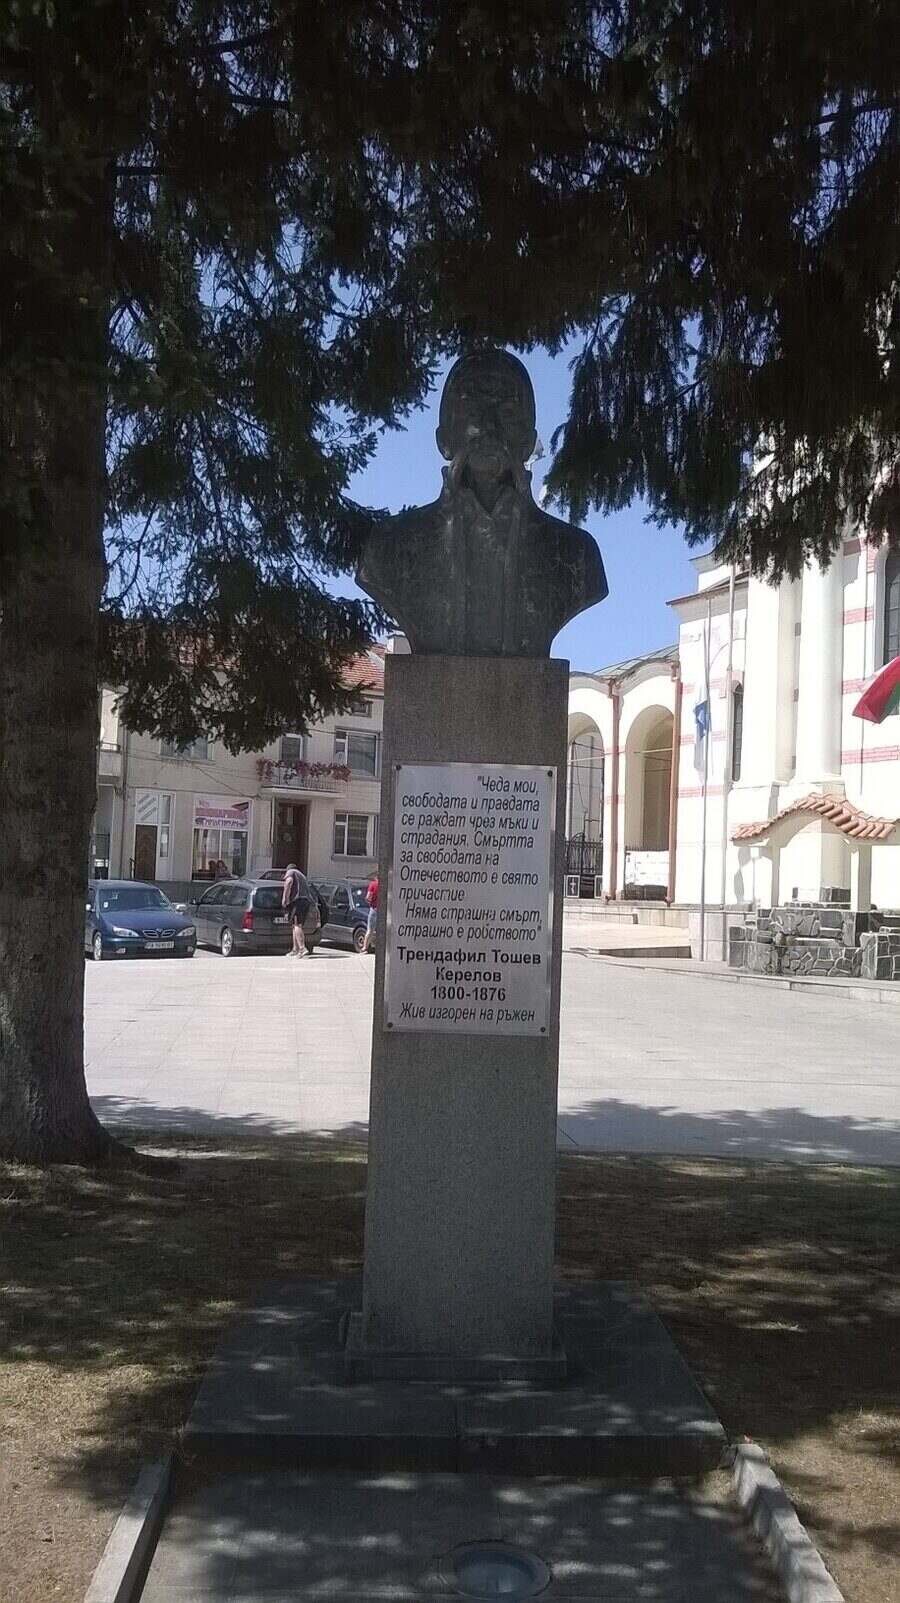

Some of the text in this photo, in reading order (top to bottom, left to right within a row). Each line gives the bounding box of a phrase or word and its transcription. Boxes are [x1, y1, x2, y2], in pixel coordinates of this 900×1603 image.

[402, 792, 539, 812] свободата и правдата
[402, 812, 539, 831] се раждат чрез мъки и
[474, 831, 534, 850] Смъртта
[400, 848, 499, 865] за свободата на
[400, 865, 538, 885] Отечеството е свято
[399, 888, 465, 902] причастие
[405, 903, 436, 919] Няма
[398, 924, 453, 940] страшно
[457, 927, 464, 937] е
[397, 946, 541, 964] Трендафил Тошев
[436, 967, 501, 984] Керелов
[399, 1002, 535, 1024] Жив изгорен на ръжен
